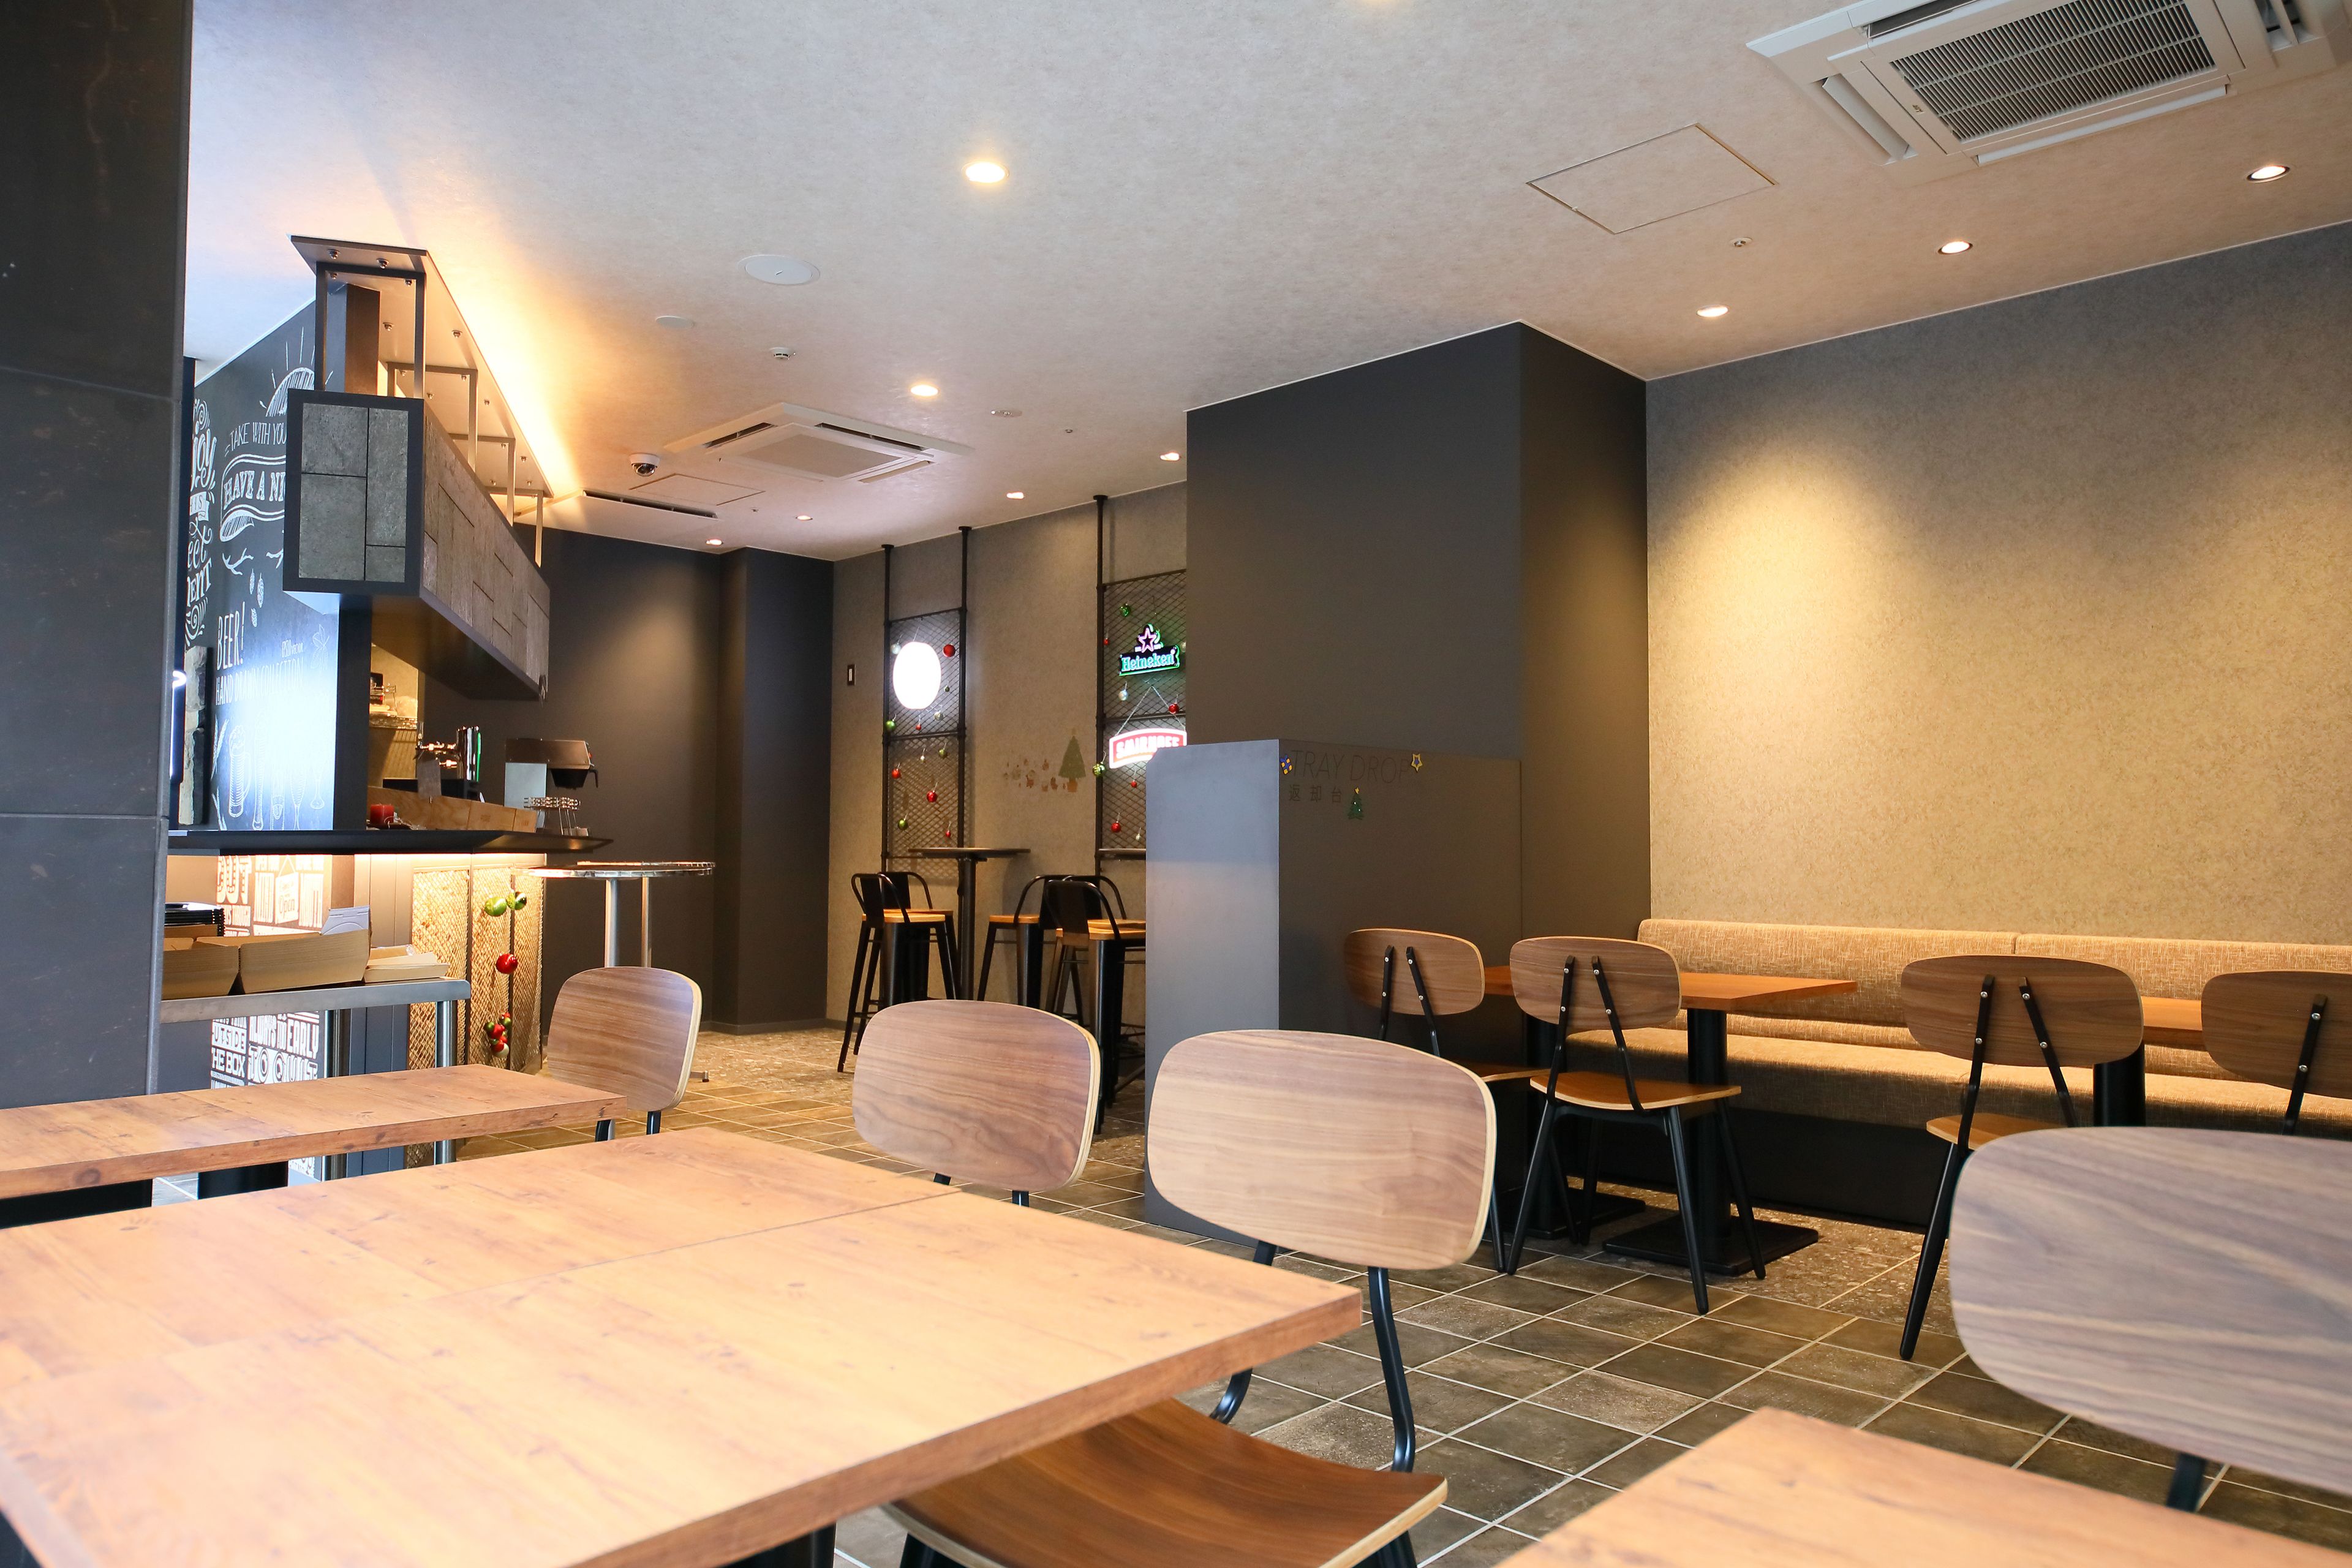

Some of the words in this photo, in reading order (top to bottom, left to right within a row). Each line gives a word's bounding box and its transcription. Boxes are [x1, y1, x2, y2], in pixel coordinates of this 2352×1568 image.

[230, 423, 251, 451] TAKE
[252, 421, 270, 445] WITH
[224, 470, 255, 510] HAVE
[256, 470, 265, 500] A
[269, 471, 286, 501] NI
[217, 601, 245, 670] BEER!
[1121, 652, 1175, 672] Heineken
[216, 674, 233, 706] HAND
[1291, 749, 1344, 780] TRAY
[1349, 755, 1409, 783] DROP
[1289, 784, 1343, 803] 返却台
[212, 1024, 246, 1050] UTSIDE
[287, 1019, 319, 1059] EARLY
[225, 1050, 246, 1079] BOX
